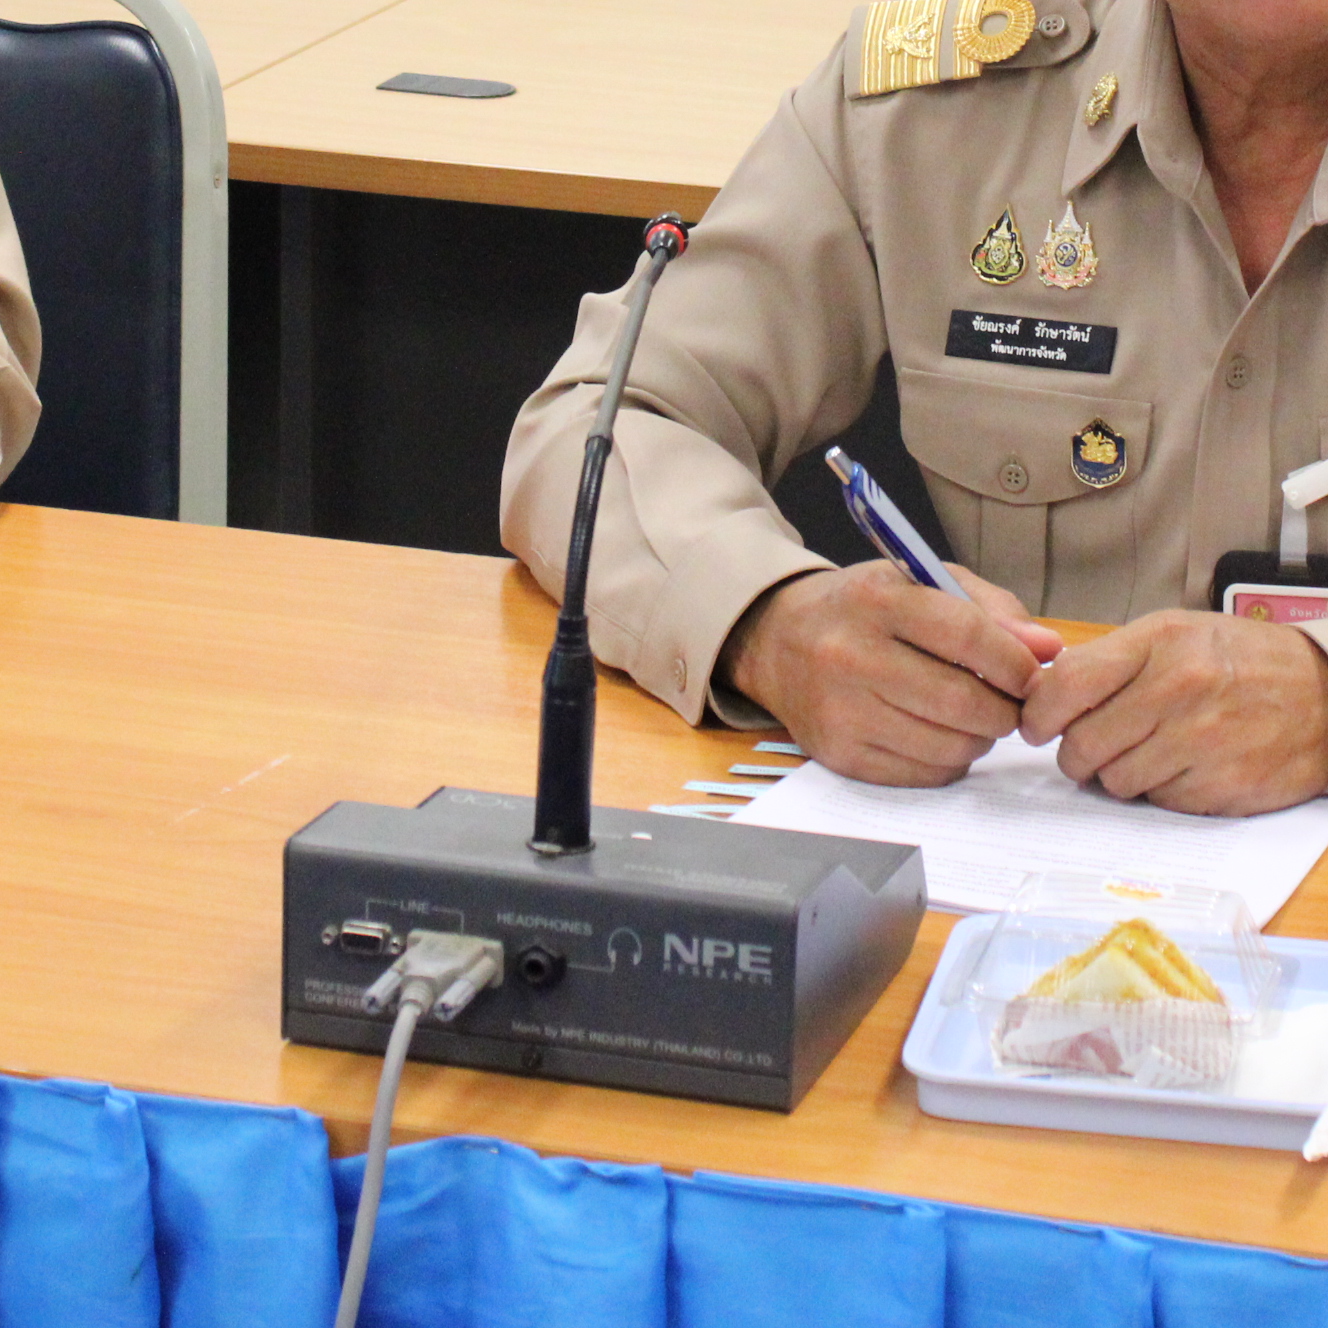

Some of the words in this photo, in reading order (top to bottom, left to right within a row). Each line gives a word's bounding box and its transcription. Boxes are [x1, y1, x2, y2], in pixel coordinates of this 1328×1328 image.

[972, 315, 1022, 336] ชัยณรงค์
[1034, 321, 1092, 343] รักษารัตน์
[990, 339, 1068, 362] พัฒนาการจังหวัด
[399, 899, 430, 915] LINE
[496, 912, 593, 936] HEADPHONES
[663, 933, 773, 975] NPE
[588, 1030, 650, 1048] INDUSTRY
